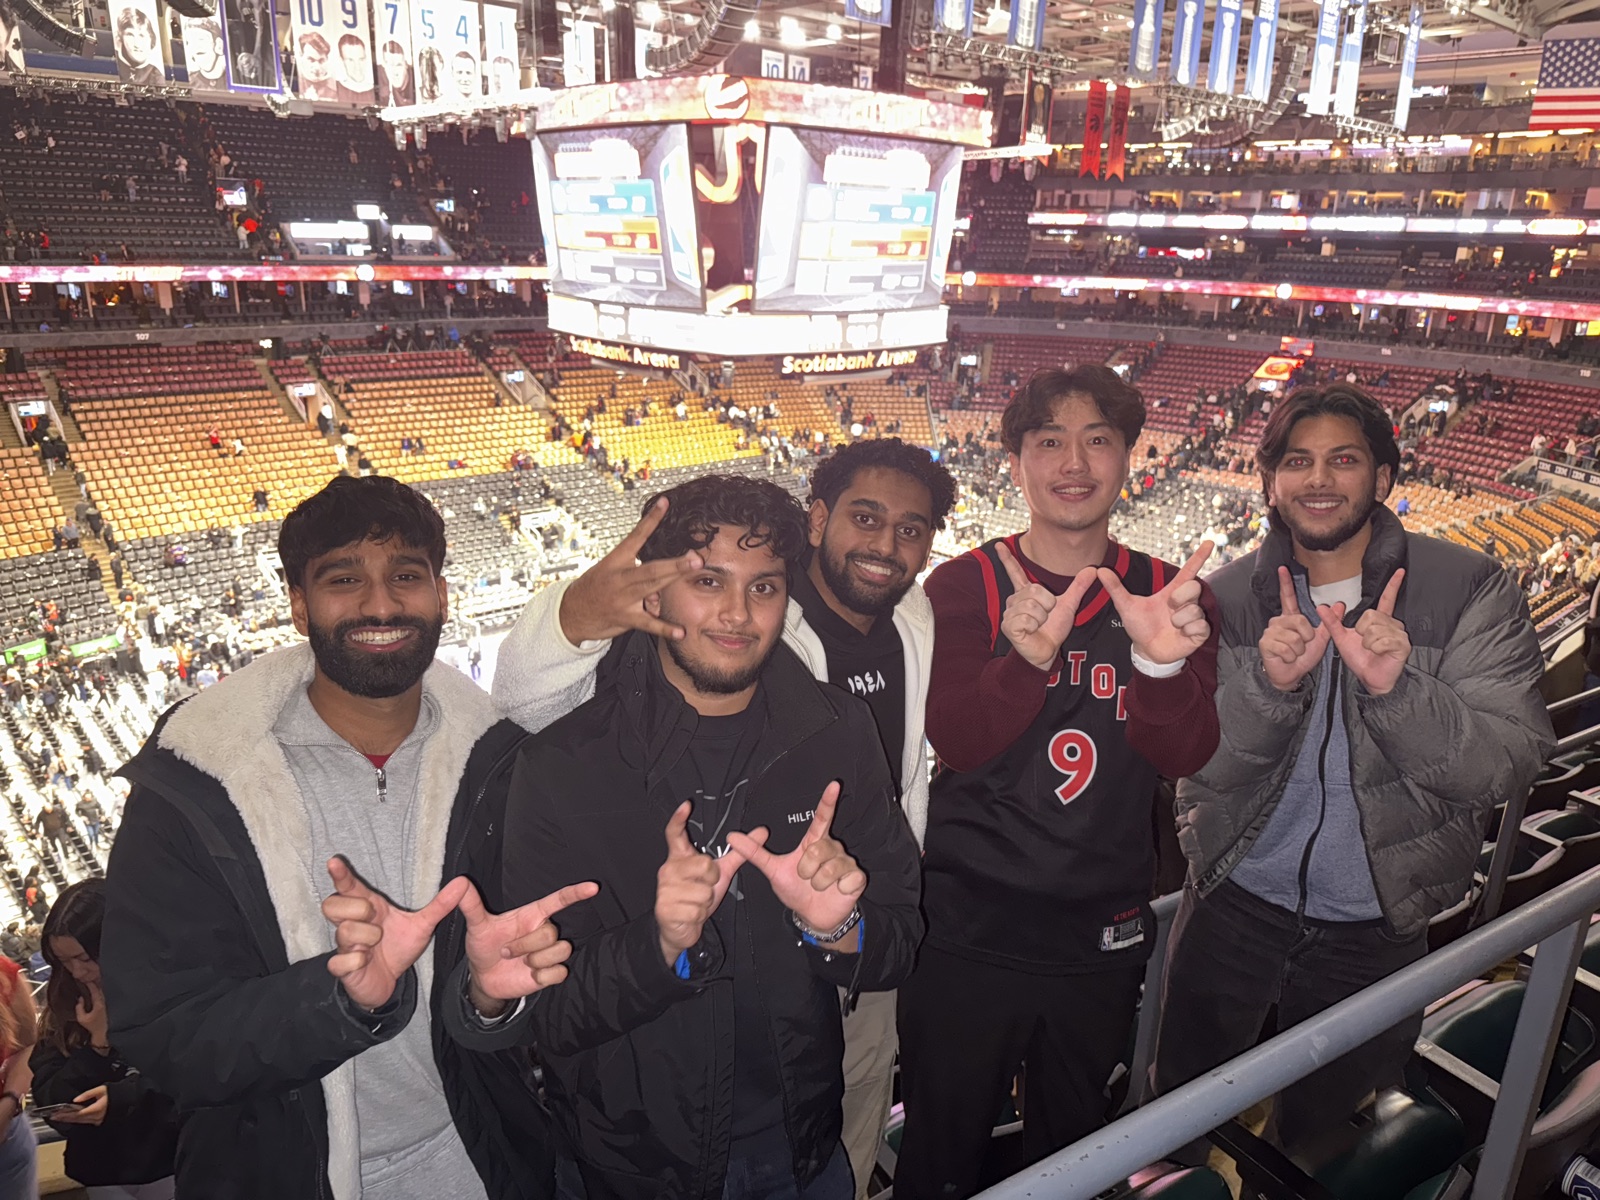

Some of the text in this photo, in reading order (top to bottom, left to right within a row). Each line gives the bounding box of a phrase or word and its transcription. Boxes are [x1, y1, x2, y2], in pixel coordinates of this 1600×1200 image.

[299, 0, 324, 27] 10
[341, 0, 358, 29] 9
[385, 3, 398, 35] 7
[421, 9, 435, 39] 5
[456, 15, 469, 44] 4
[135, 332, 150, 341] 107
[633, 347, 680, 370] Arena
[781, 349, 917, 374] Scotiabank Arena
[1538, 461, 1551, 472] IBM
[1554, 465, 1569, 477] IBM
[1571, 469, 1586, 481] IBM
[1048, 728, 1097, 805] 9
[787, 809, 817, 824] HILFI
